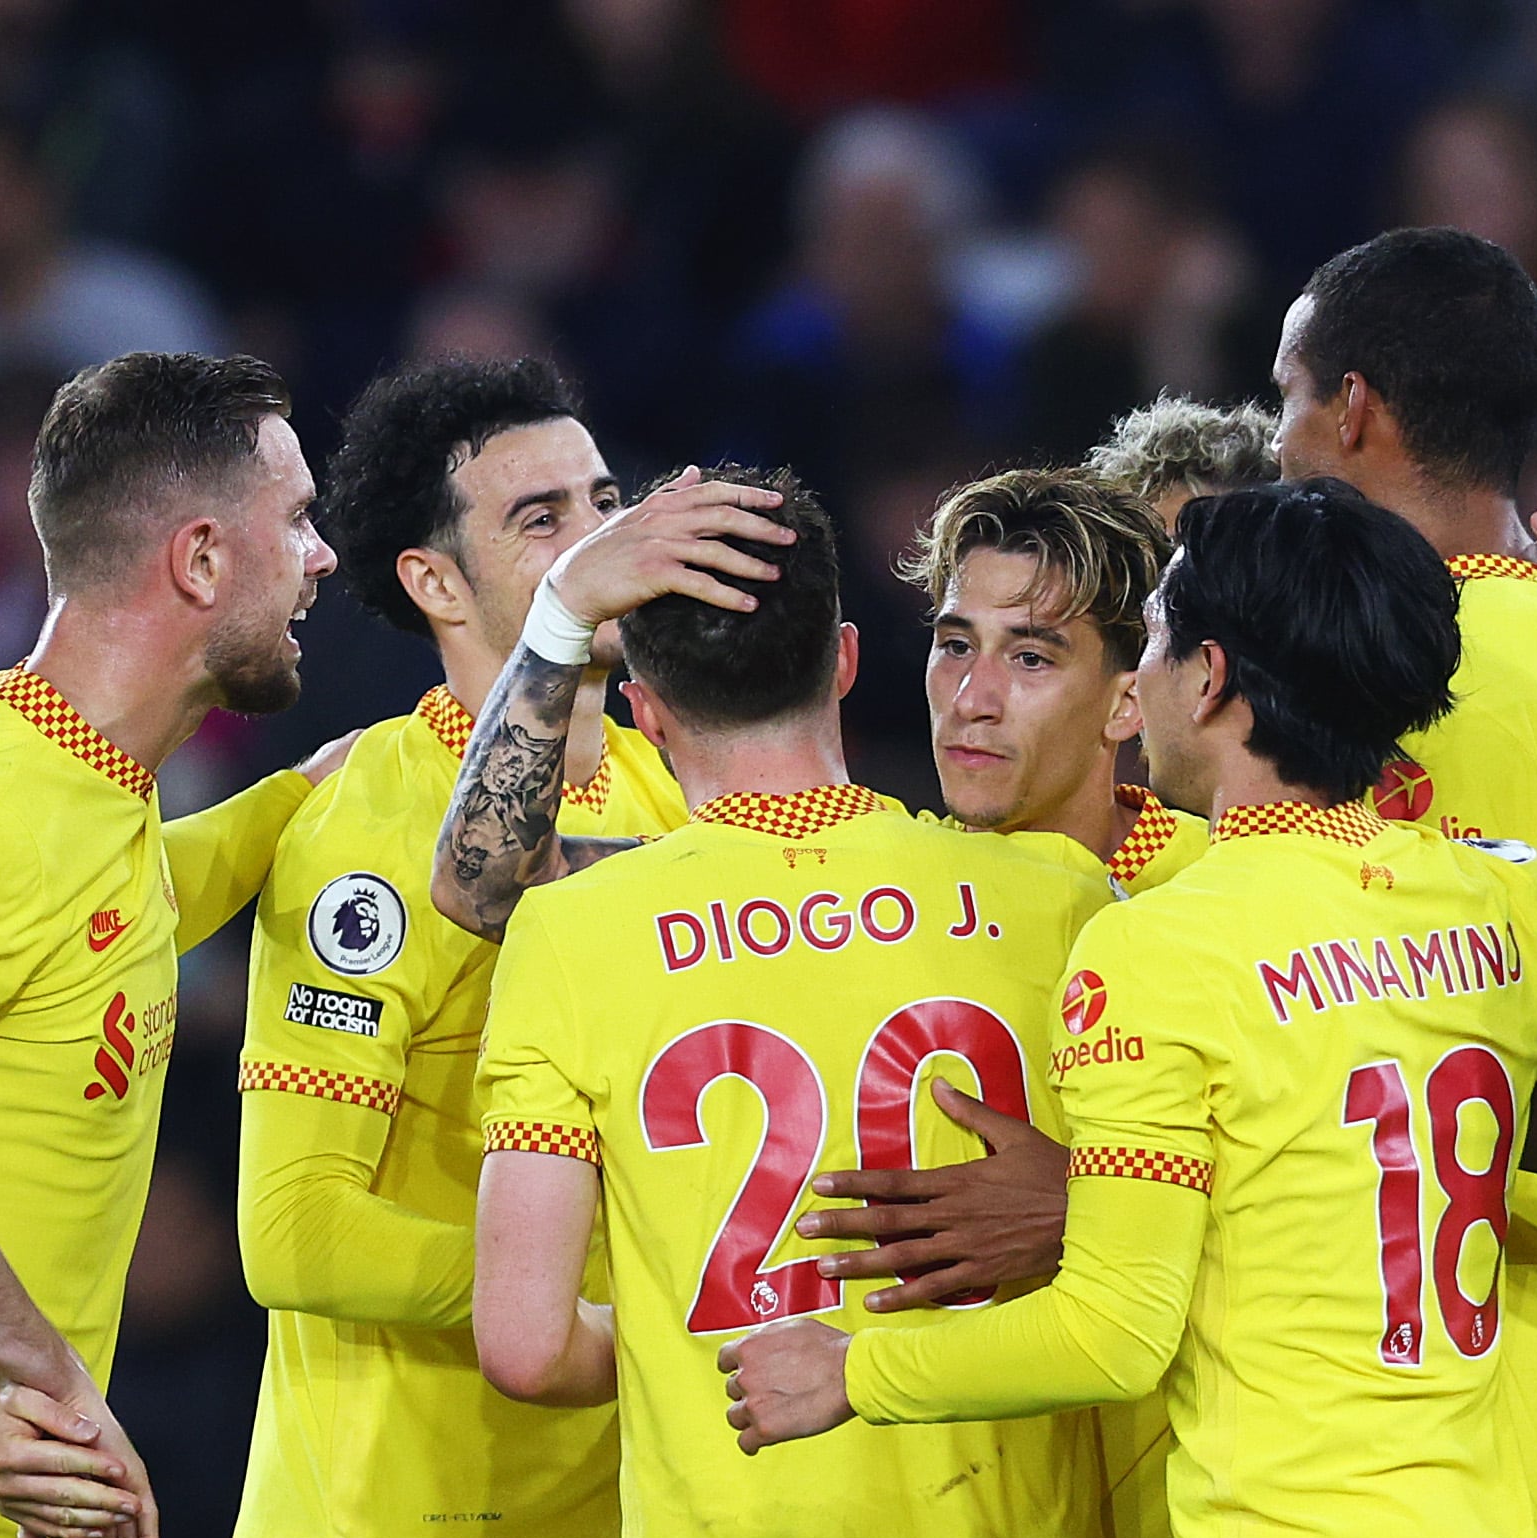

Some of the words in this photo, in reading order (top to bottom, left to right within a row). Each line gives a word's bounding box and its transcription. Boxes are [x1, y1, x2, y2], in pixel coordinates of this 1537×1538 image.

[91, 909, 121, 934] NIKE
[654, 886, 917, 974] DIOGO
[947, 883, 1001, 941] J.
[340, 955, 371, 966] Premier
[372, 933, 393, 960] League
[285, 1001, 311, 1024] for
[312, 1010, 378, 1037] racism
[290, 983, 313, 1006] No
[316, 992, 372, 1018] room
[1048, 1026, 1145, 1082] xpedia
[639, 996, 1032, 1336] 20
[1341, 1043, 1517, 1367] 18
